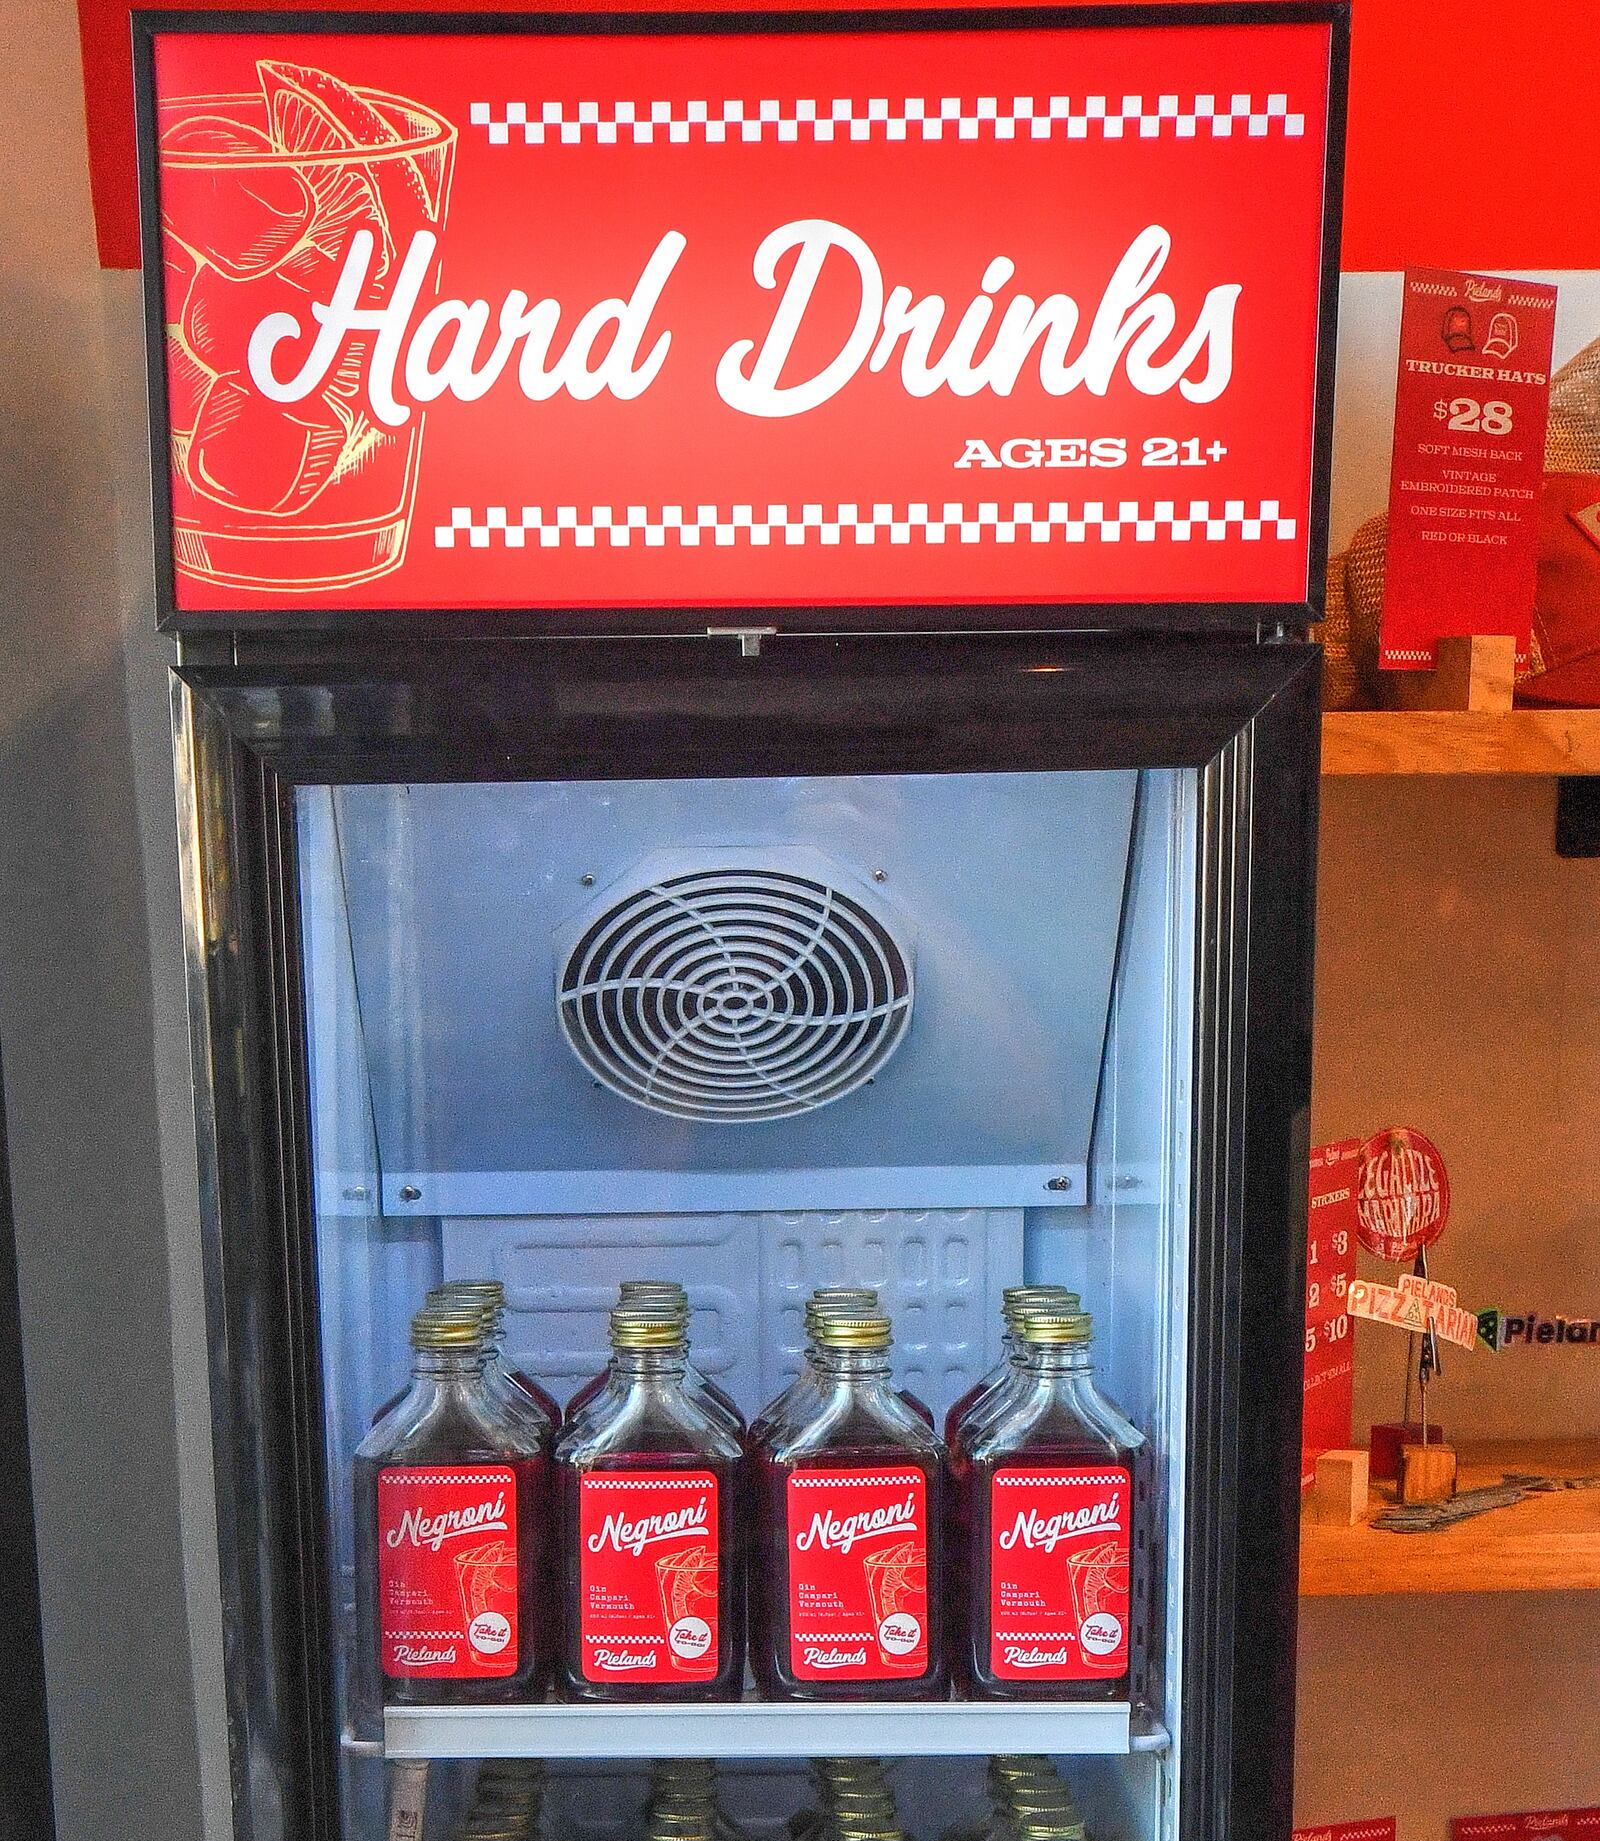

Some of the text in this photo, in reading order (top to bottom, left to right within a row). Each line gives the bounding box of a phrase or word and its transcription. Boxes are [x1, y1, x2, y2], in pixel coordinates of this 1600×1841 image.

[246, 219, 1241, 428] Hard Drinks
[1405, 359, 1547, 385] TRUCKER HATS
[1433, 397, 1513, 436] $28
[954, 436, 1228, 469] AGES 21+
[1418, 443, 1523, 461] SOFT MESH BACK
[1442, 469, 1497, 483] VINTAGE
[1400, 480, 1534, 499] EMBROIDERED PATCH
[1411, 505, 1521, 522] ONE SIZE FITS ALL
[1421, 531, 1508, 545] RED OR BLACK
[1308, 1282, 1320, 1308] 2
[1323, 1314, 1348, 1343] $10
[1504, 1312, 1600, 1344] Pielan
[386, 1491, 508, 1551] Negroni
[588, 1496, 709, 1557] Negroni
[796, 1492, 918, 1554] Negroni
[999, 1492, 1121, 1554] Negroni
[798, 1592, 838, 1601] Campari
[798, 1600, 844, 1608] Vermouth
[1000, 1590, 1040, 1599] Campari
[1000, 1599, 1046, 1607] Vermouth
[590, 1602, 635, 1610] Vermouth
[674, 1628, 697, 1641] Take
[884, 1625, 907, 1637] Take
[1085, 1624, 1108, 1638] Take
[393, 1645, 456, 1666] Pielands
[593, 1649, 657, 1671] Pielands
[803, 1647, 867, 1669] Pielands
[1003, 1646, 1068, 1668] Pielands
